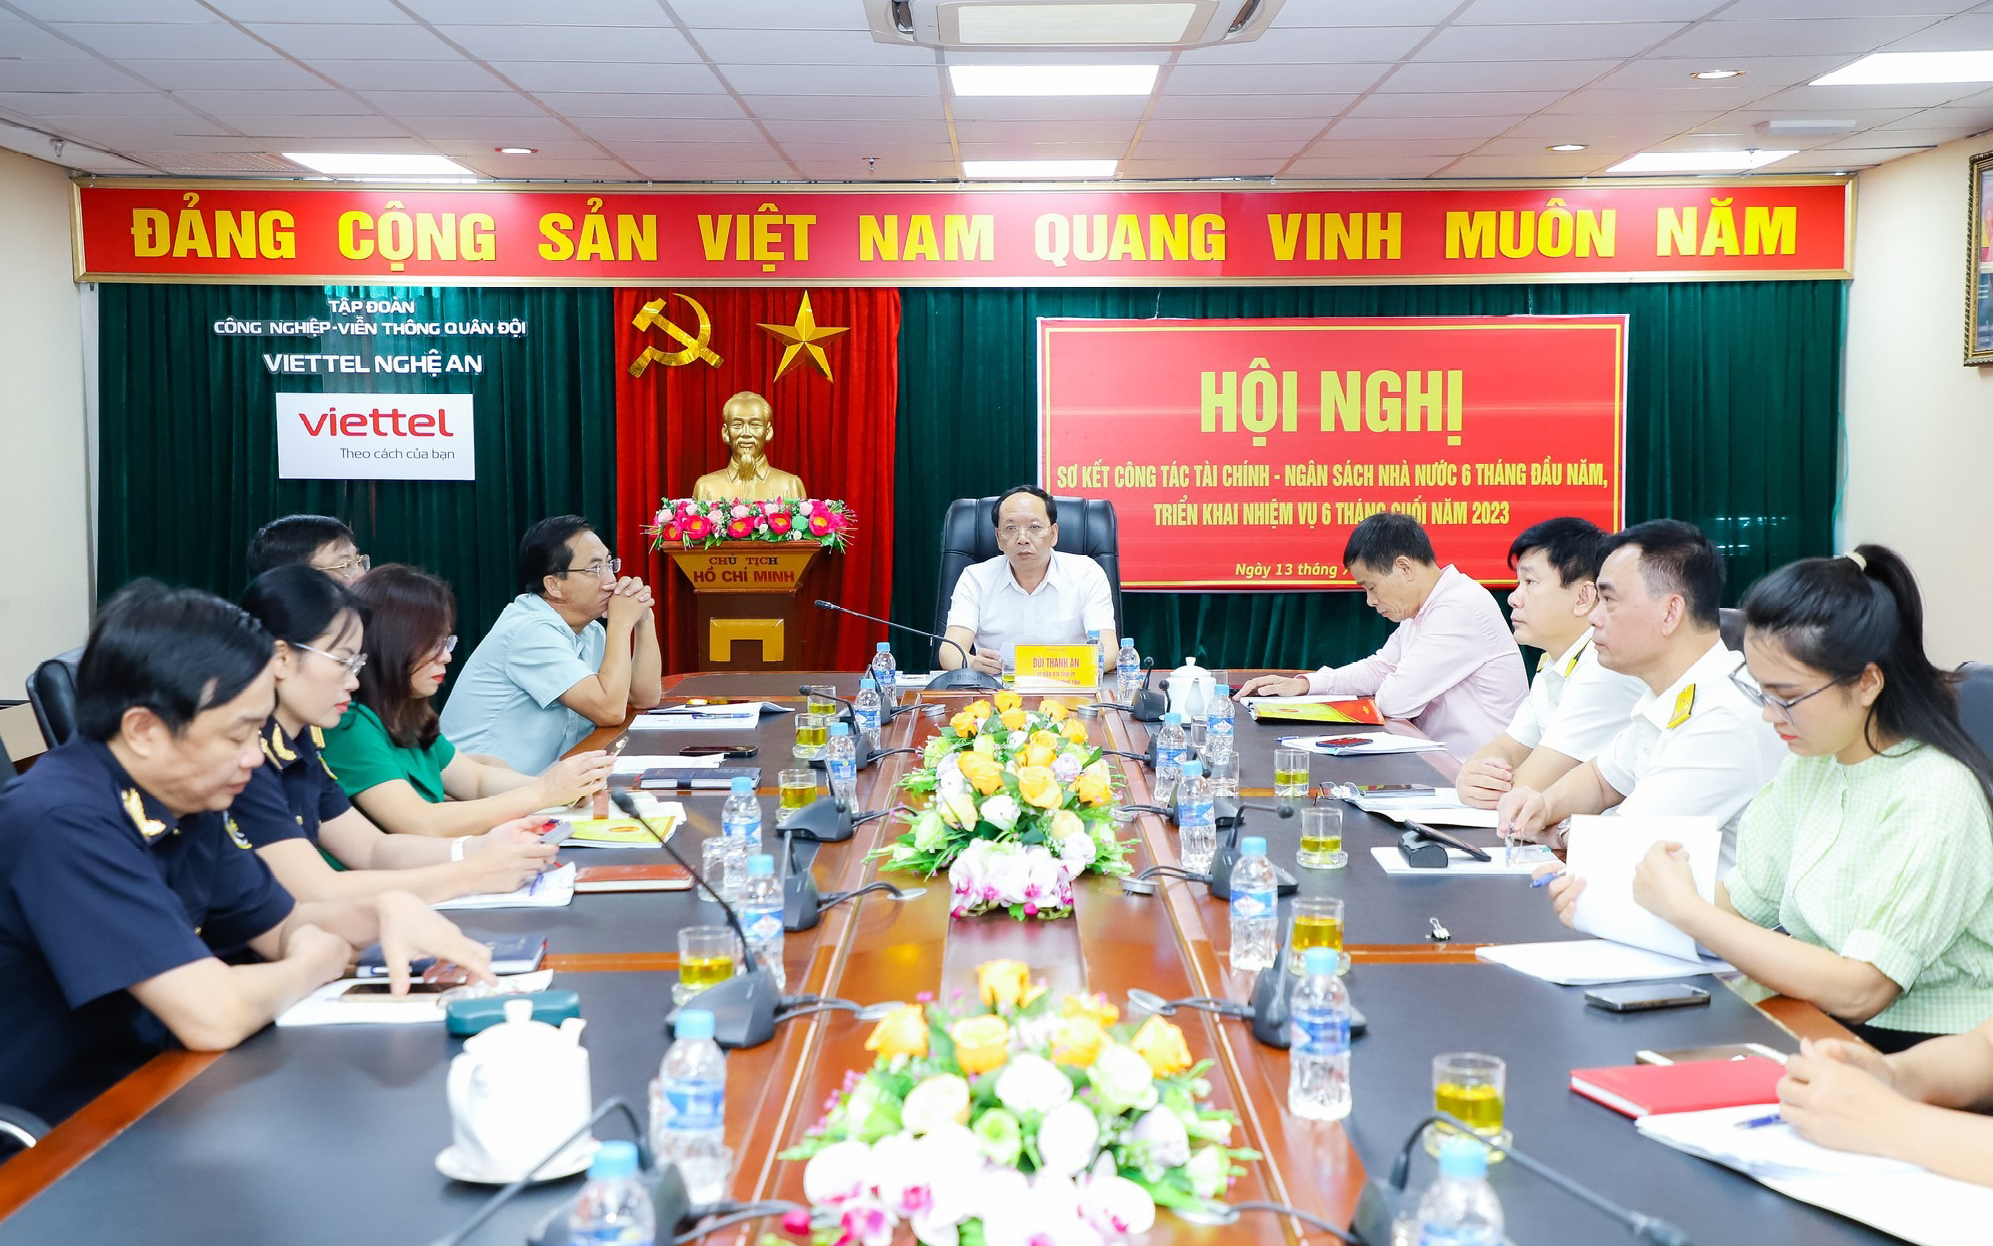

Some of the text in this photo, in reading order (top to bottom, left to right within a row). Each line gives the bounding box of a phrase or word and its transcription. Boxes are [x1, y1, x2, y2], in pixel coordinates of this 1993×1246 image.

[131, 192, 1797, 272] ĐẢNG CỘNG SẢN VIỆT NAM QUANG VINH MUÔN NĂM
[328, 296, 415, 316] TẬP ĐOÀN
[213, 318, 262, 335] CÔNG
[381, 319, 441, 335] THÔNG
[444, 319, 494, 335] QUÂN
[497, 319, 526, 338] ĐỘI
[263, 348, 483, 377] VIETTEL NGHỆ AN
[1201, 357, 1463, 447] HỘI NGHỊ
[298, 407, 454, 437] viettel
[340, 447, 455, 461] Theo cách của bạn
[1057, 464, 1079, 489] SƠ
[1082, 459, 1111, 488] KẾT
[1114, 461, 1157, 488] CÔNG
[1160, 461, 1190, 488] TÁC
[1194, 460, 1218, 487] TÀI
[1222, 460, 1270, 487] CHÍNH
[1284, 460, 1328, 487] NGÂN
[1333, 460, 1374, 487] SÁCH
[1378, 460, 1411, 487] NHÀ
[1415, 461, 1457, 487] NƯỚC
[1461, 463, 1471, 486] 6
[1476, 459, 1527, 486] THÁNG
[1531, 455, 1562, 486] ĐẦU
[1567, 459, 1608, 488] NĂM,
[1154, 495, 1198, 526] TRIỂN
[1203, 502, 1238, 526] KHAI
[1243, 498, 1293, 529] NHIỆM
[1298, 502, 1318, 529] VỤ
[1321, 502, 1332, 525] 6
[1431, 498, 1467, 525] NĂM
[1472, 500, 1510, 525] 2023
[745, 557, 778, 567] TỊCH
[1235, 562, 1271, 579] Ngày
[1275, 563, 1293, 576] 13
[1297, 562, 1338, 579] tháng
[693, 566, 795, 583] HỒ CHÍ MINH
[1046, 657, 1068, 668] THANH
[1069, 657, 1080, 668] AN
